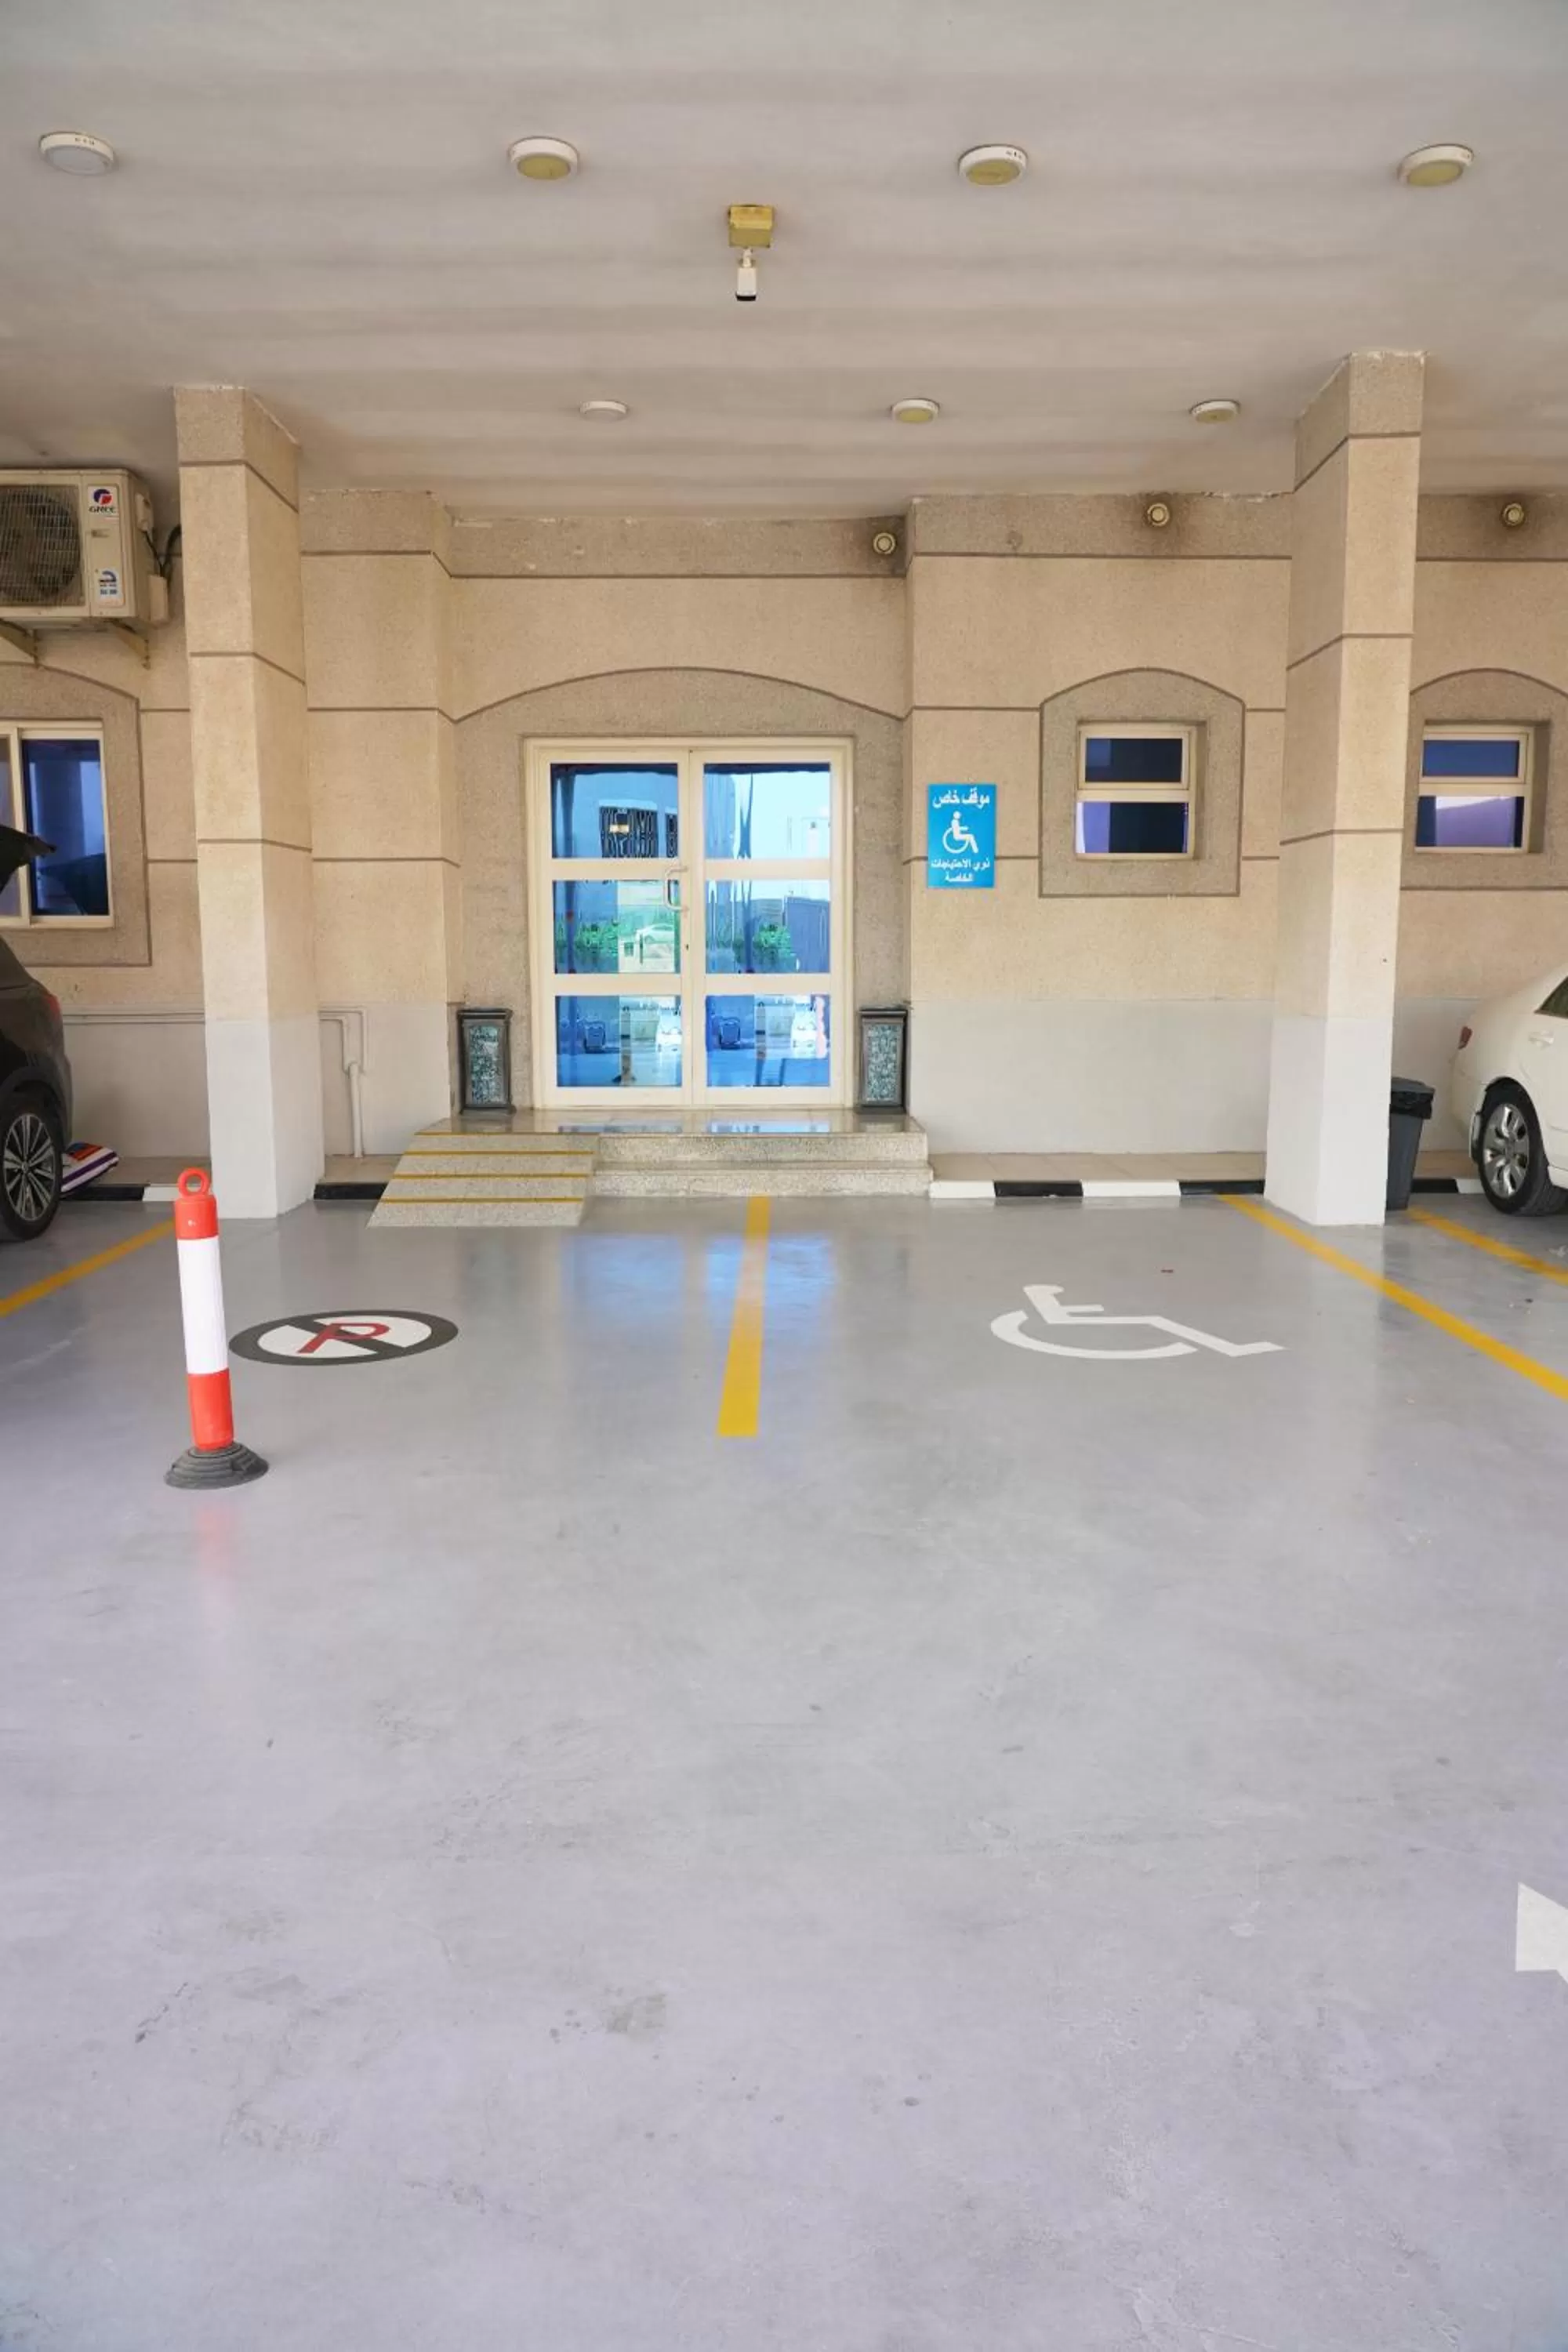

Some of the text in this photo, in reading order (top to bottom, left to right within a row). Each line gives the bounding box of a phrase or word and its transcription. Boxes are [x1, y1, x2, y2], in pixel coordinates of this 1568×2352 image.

[932, 787, 990, 810] موقف خاص
[297, 1323, 390, 1354] P
